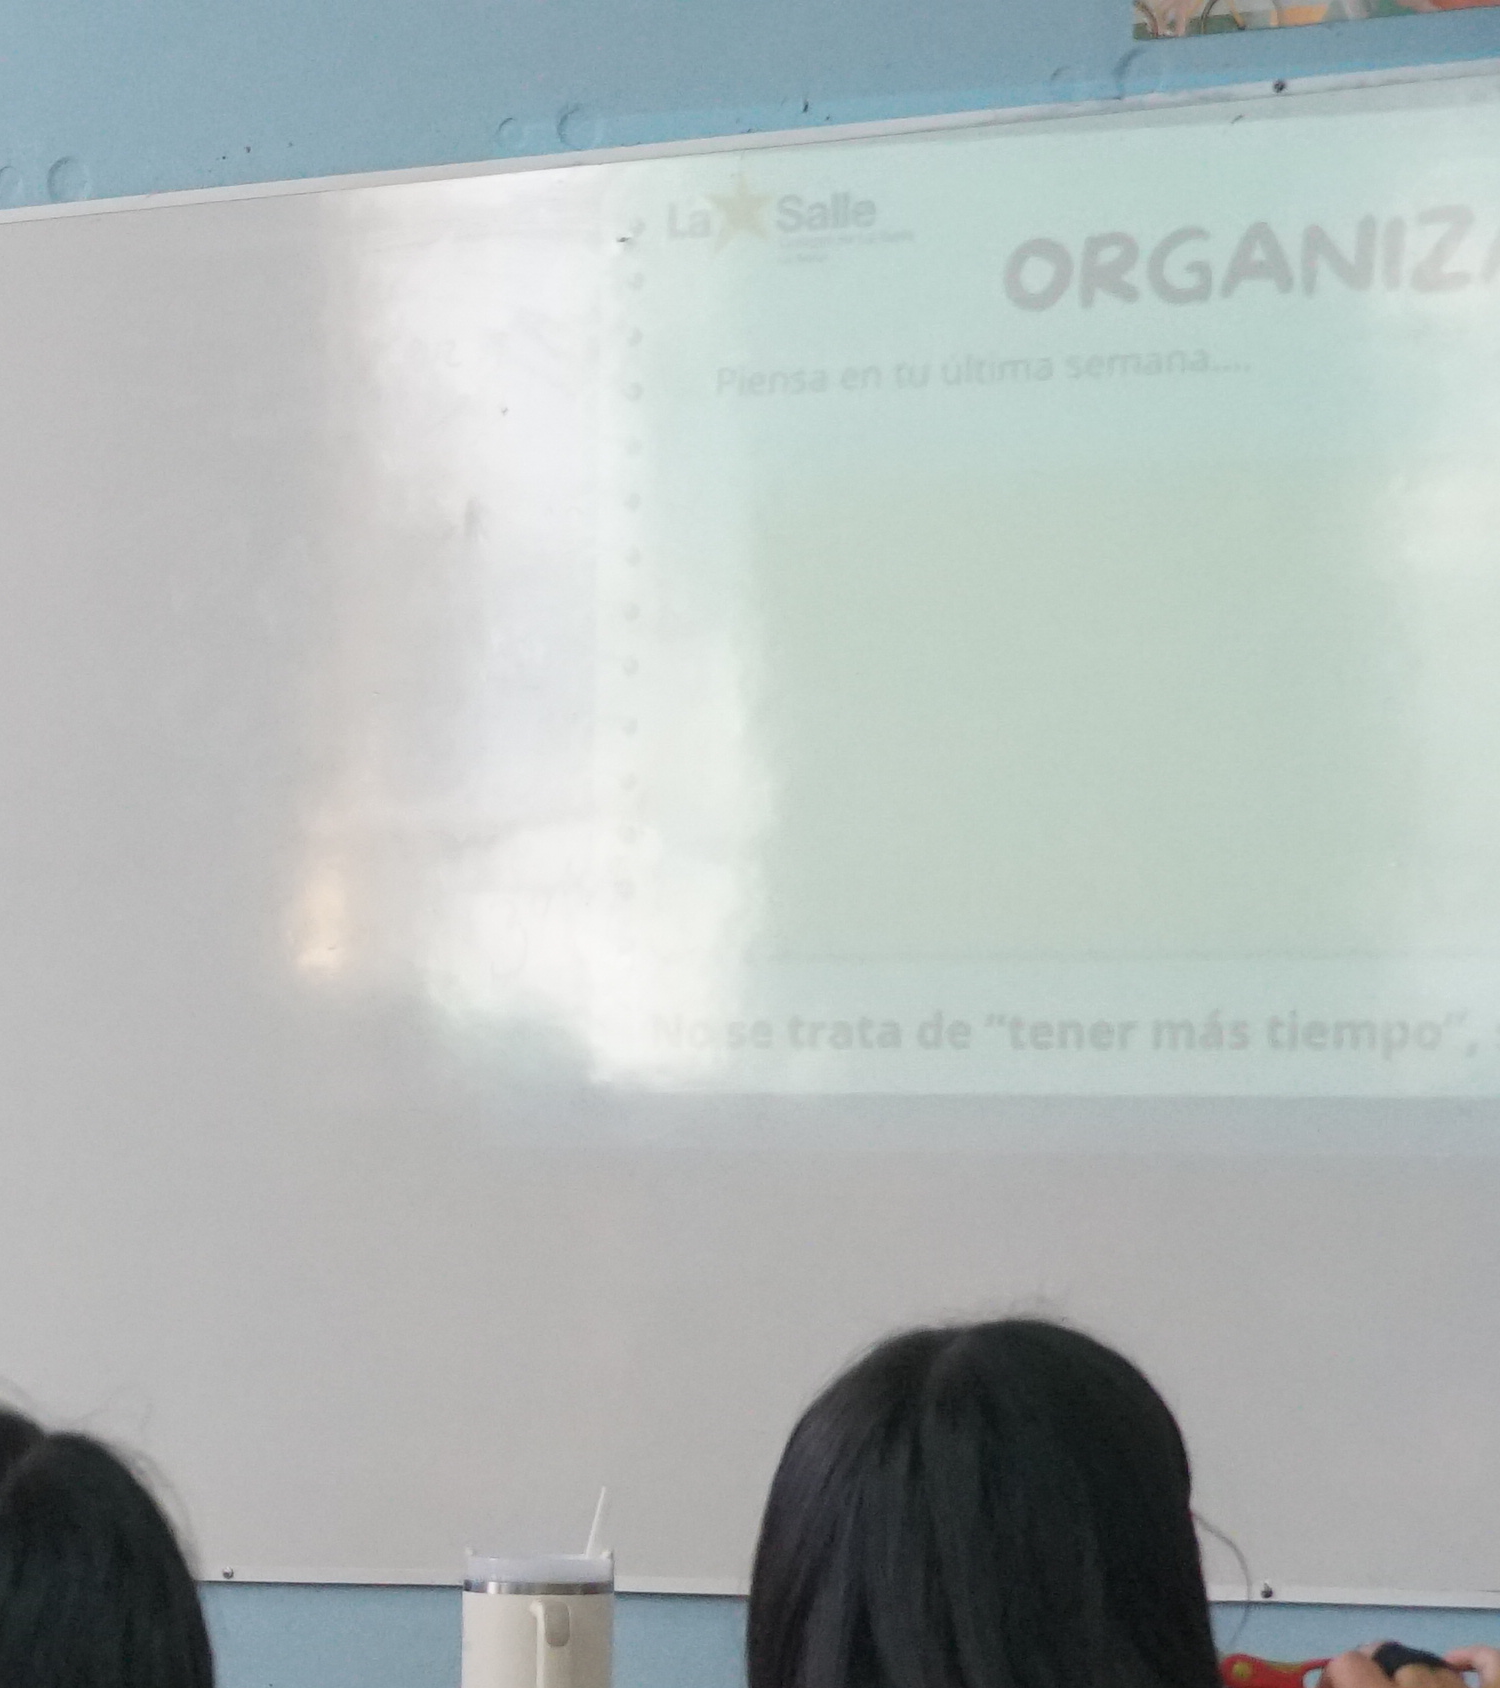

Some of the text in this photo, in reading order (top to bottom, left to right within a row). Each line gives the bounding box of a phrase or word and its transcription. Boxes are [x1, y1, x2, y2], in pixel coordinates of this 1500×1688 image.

[666, 191, 877, 240] La Salle
[715, 364, 828, 397] Piensa
[841, 364, 883, 391] en
[894, 358, 931, 388] tu
[941, 351, 1054, 385] última
[723, 1019, 774, 1051] se
[786, 1013, 901, 1051] trata
[915, 1008, 973, 1051] de
[1150, 1010, 1252, 1052] más
